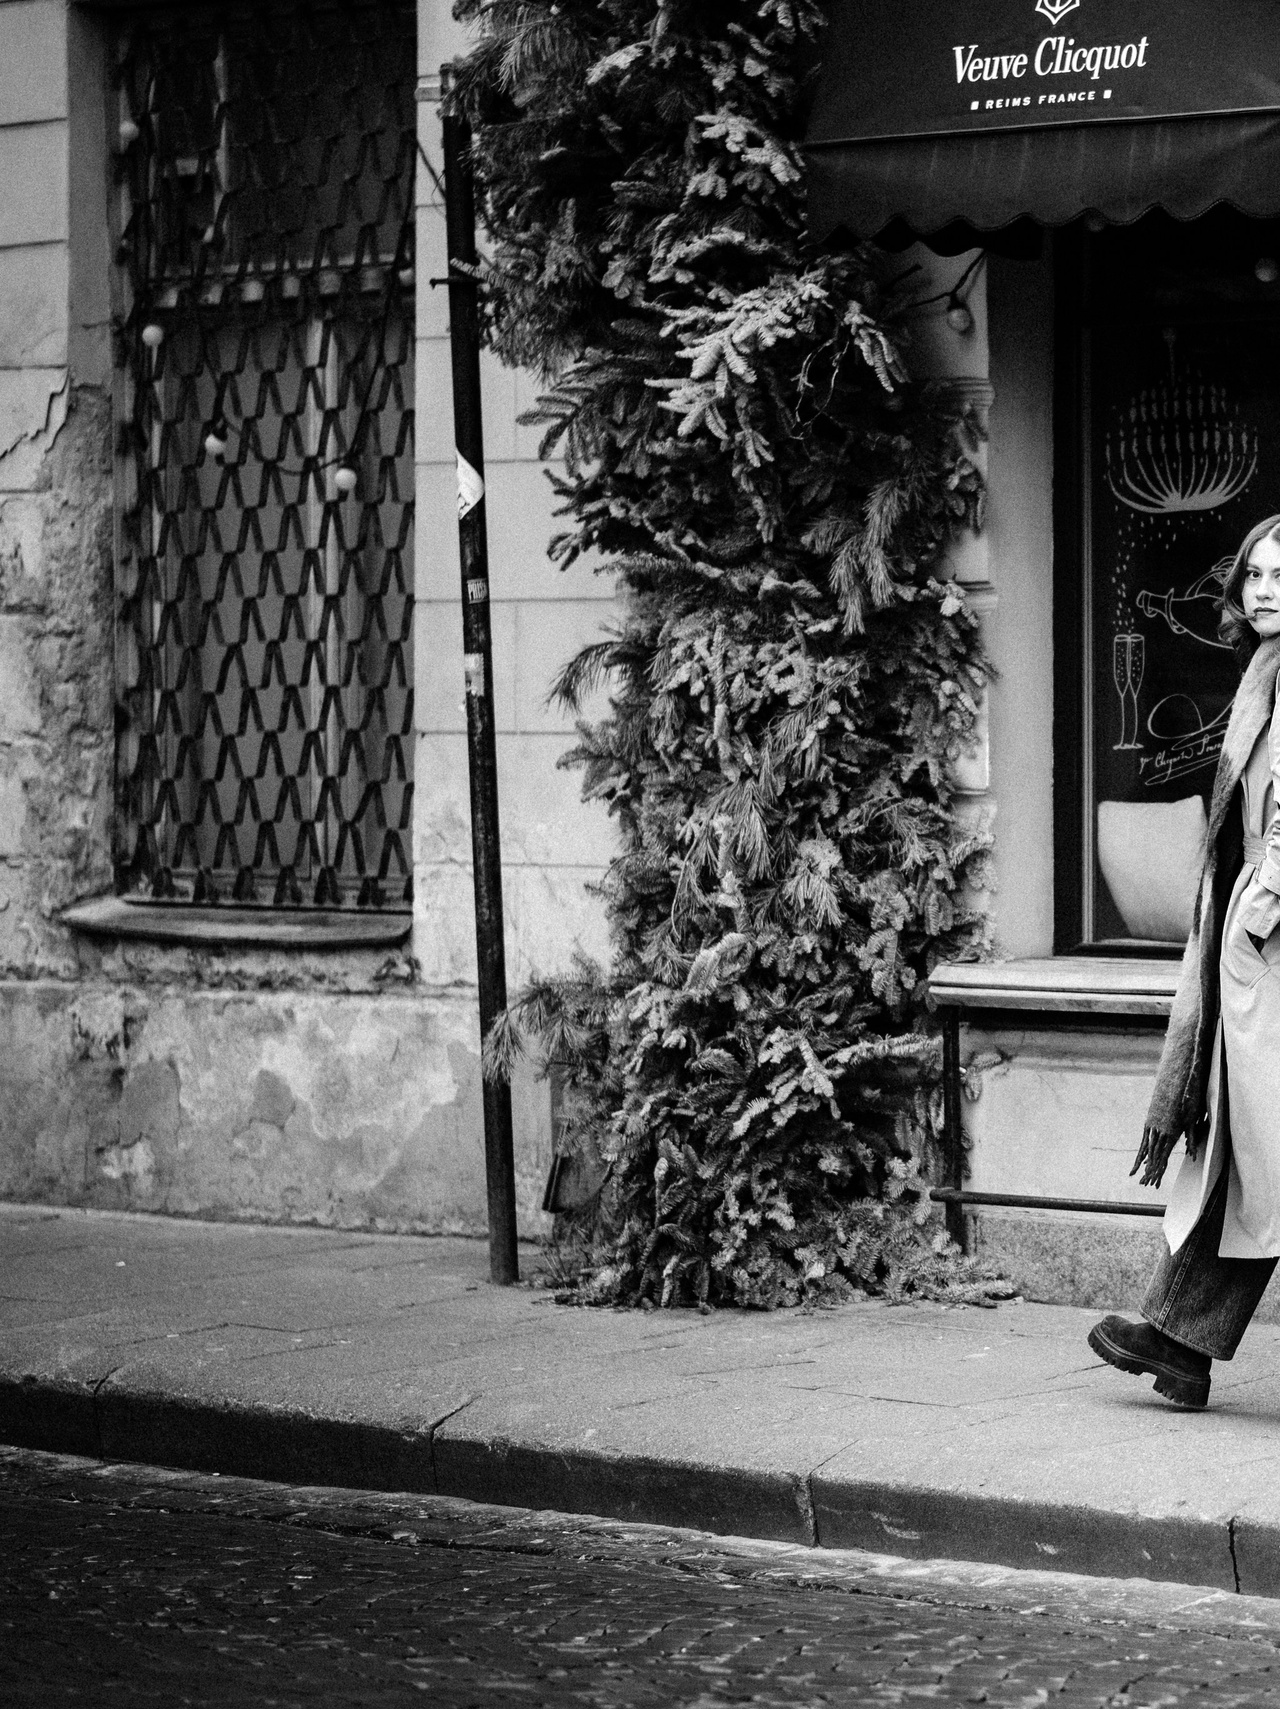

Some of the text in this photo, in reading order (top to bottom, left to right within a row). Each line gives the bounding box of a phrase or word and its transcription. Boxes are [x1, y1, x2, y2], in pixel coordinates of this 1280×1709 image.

[952, 36, 1150, 84] Veuve Clicquot
[985, 91, 1096, 110] REIMS FRANCE
